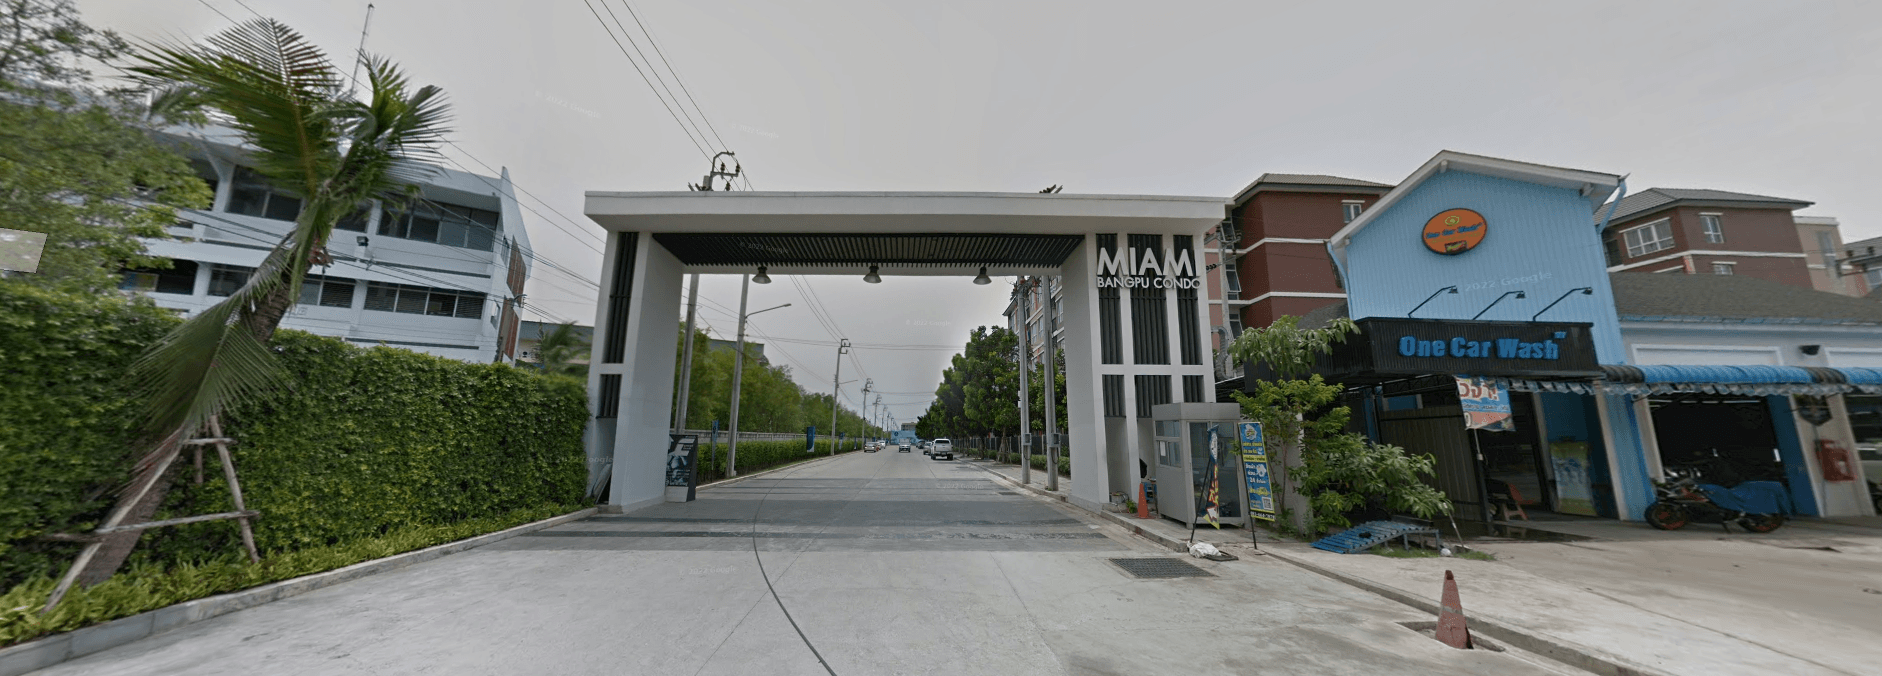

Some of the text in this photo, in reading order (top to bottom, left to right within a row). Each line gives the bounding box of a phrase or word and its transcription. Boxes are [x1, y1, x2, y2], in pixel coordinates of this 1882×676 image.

[1097, 247, 1201, 277] MIAMI
[1097, 277, 1201, 289] BANGPU CONDO
[1400, 335, 1559, 360] One Car Wash
